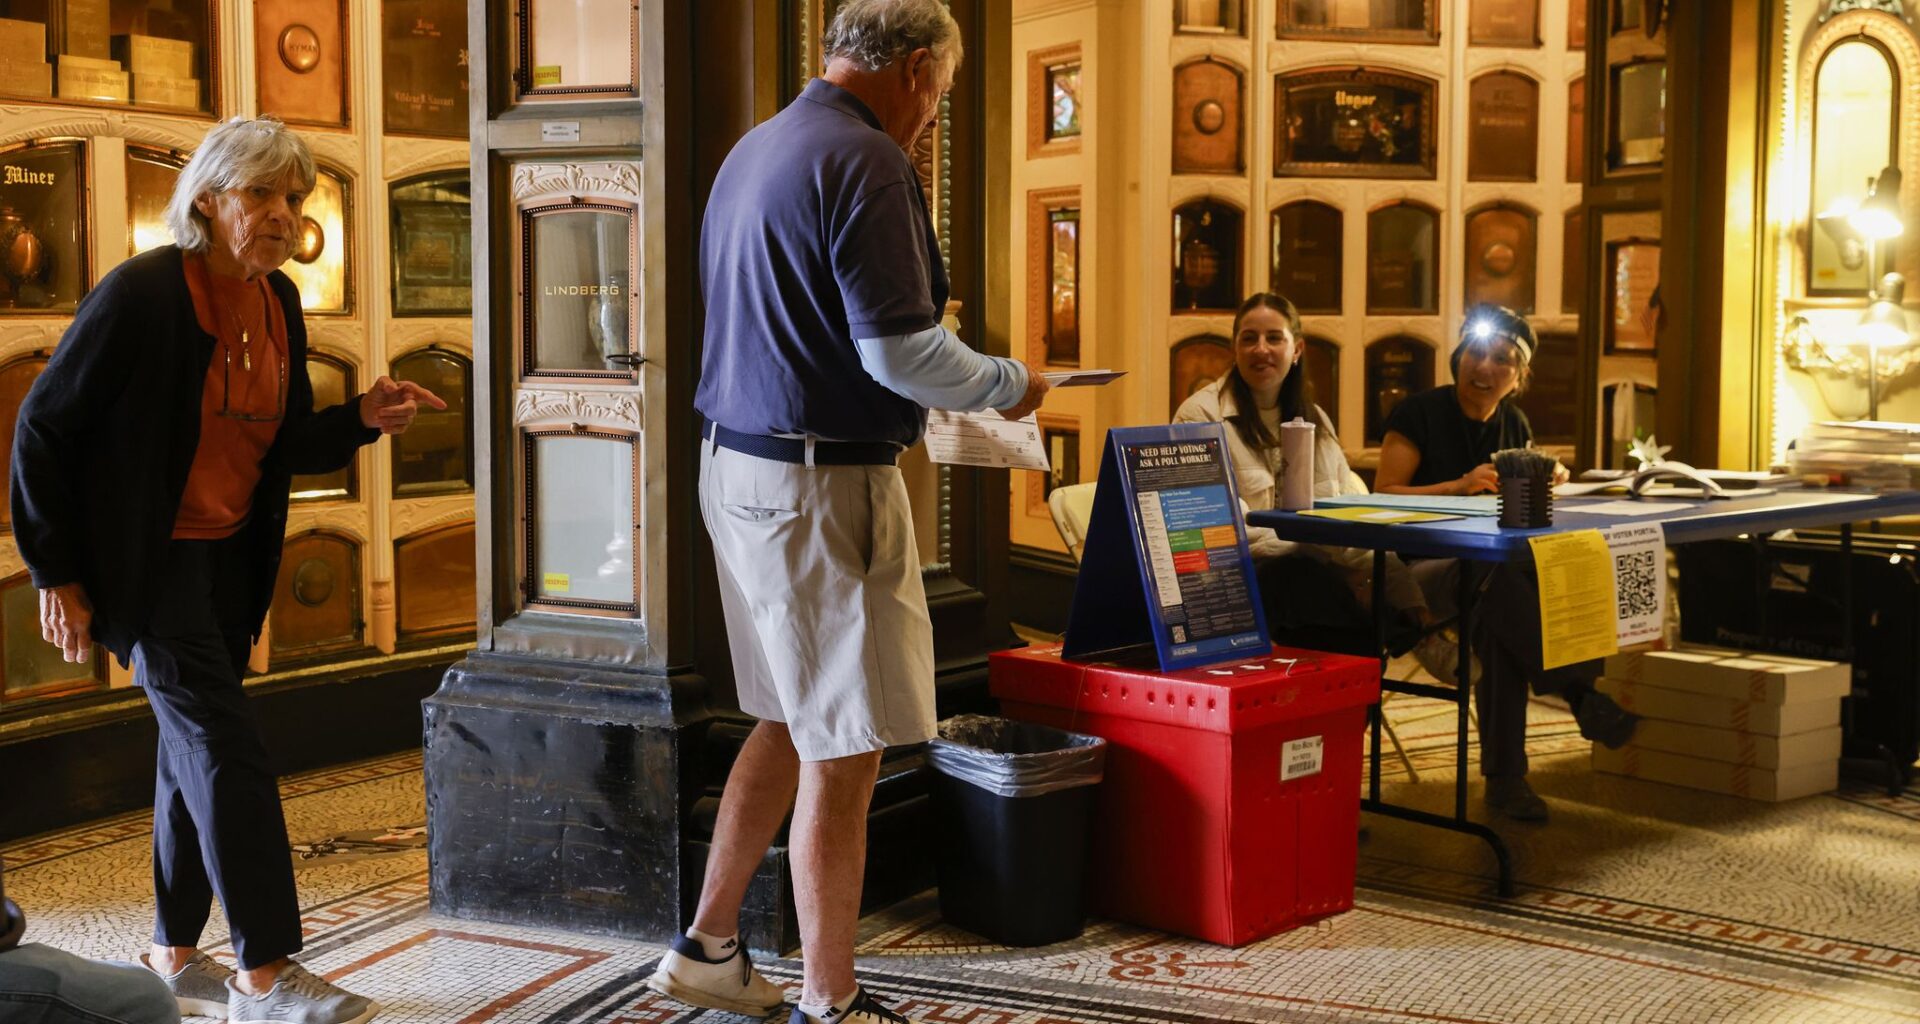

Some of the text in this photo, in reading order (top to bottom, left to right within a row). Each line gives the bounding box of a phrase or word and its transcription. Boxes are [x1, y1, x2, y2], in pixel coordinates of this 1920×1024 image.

[1335, 90, 1377, 110] Ungar
[4, 165, 55, 185] Miner
[545, 285, 619, 296] LINDBERG
[1139, 443, 1207, 457] NEED HELP VOTING?
[1139, 453, 1212, 468] ASK A POLL WORKER!
[1613, 529, 1632, 539] VOTER
[1633, 527, 1657, 537] PORTAL
